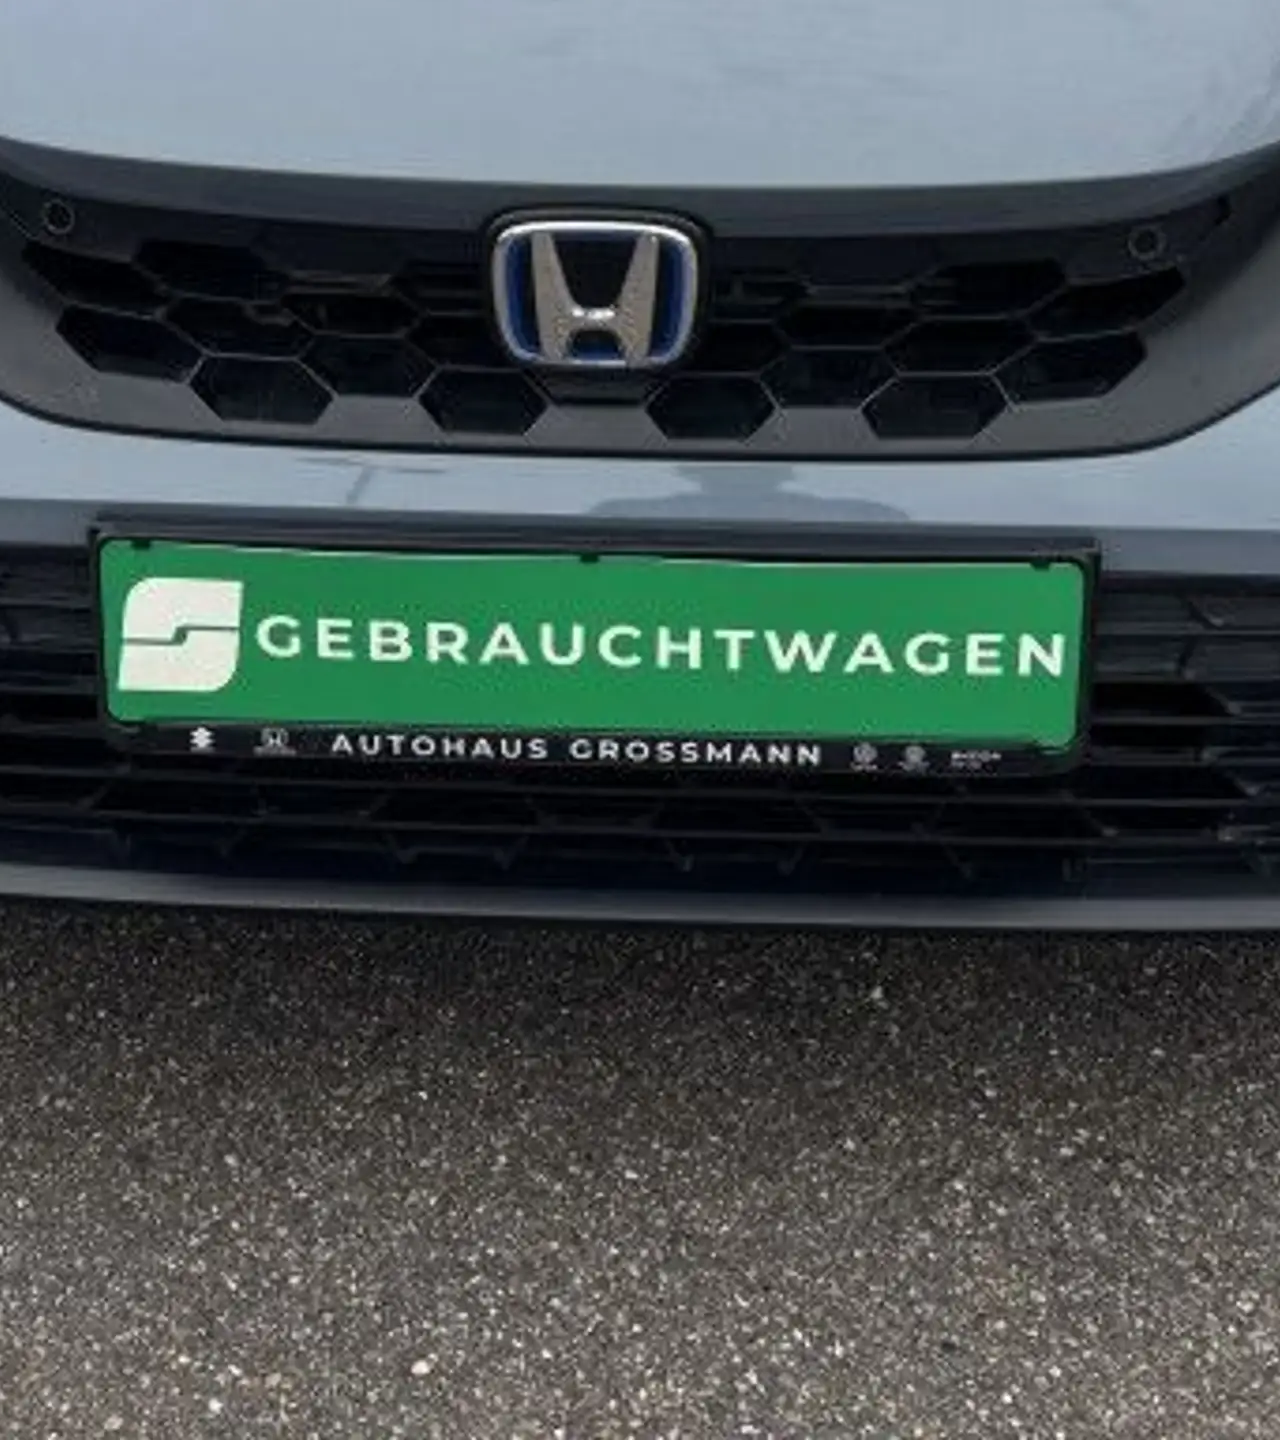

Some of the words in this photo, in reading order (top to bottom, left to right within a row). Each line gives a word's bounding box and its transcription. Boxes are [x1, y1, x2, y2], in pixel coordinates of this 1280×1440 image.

[255, 615, 1066, 677] GEBRAUCHTWAGEN
[331, 733, 549, 759] AUTOHAUS
[568, 738, 821, 766] GROSSMANN
